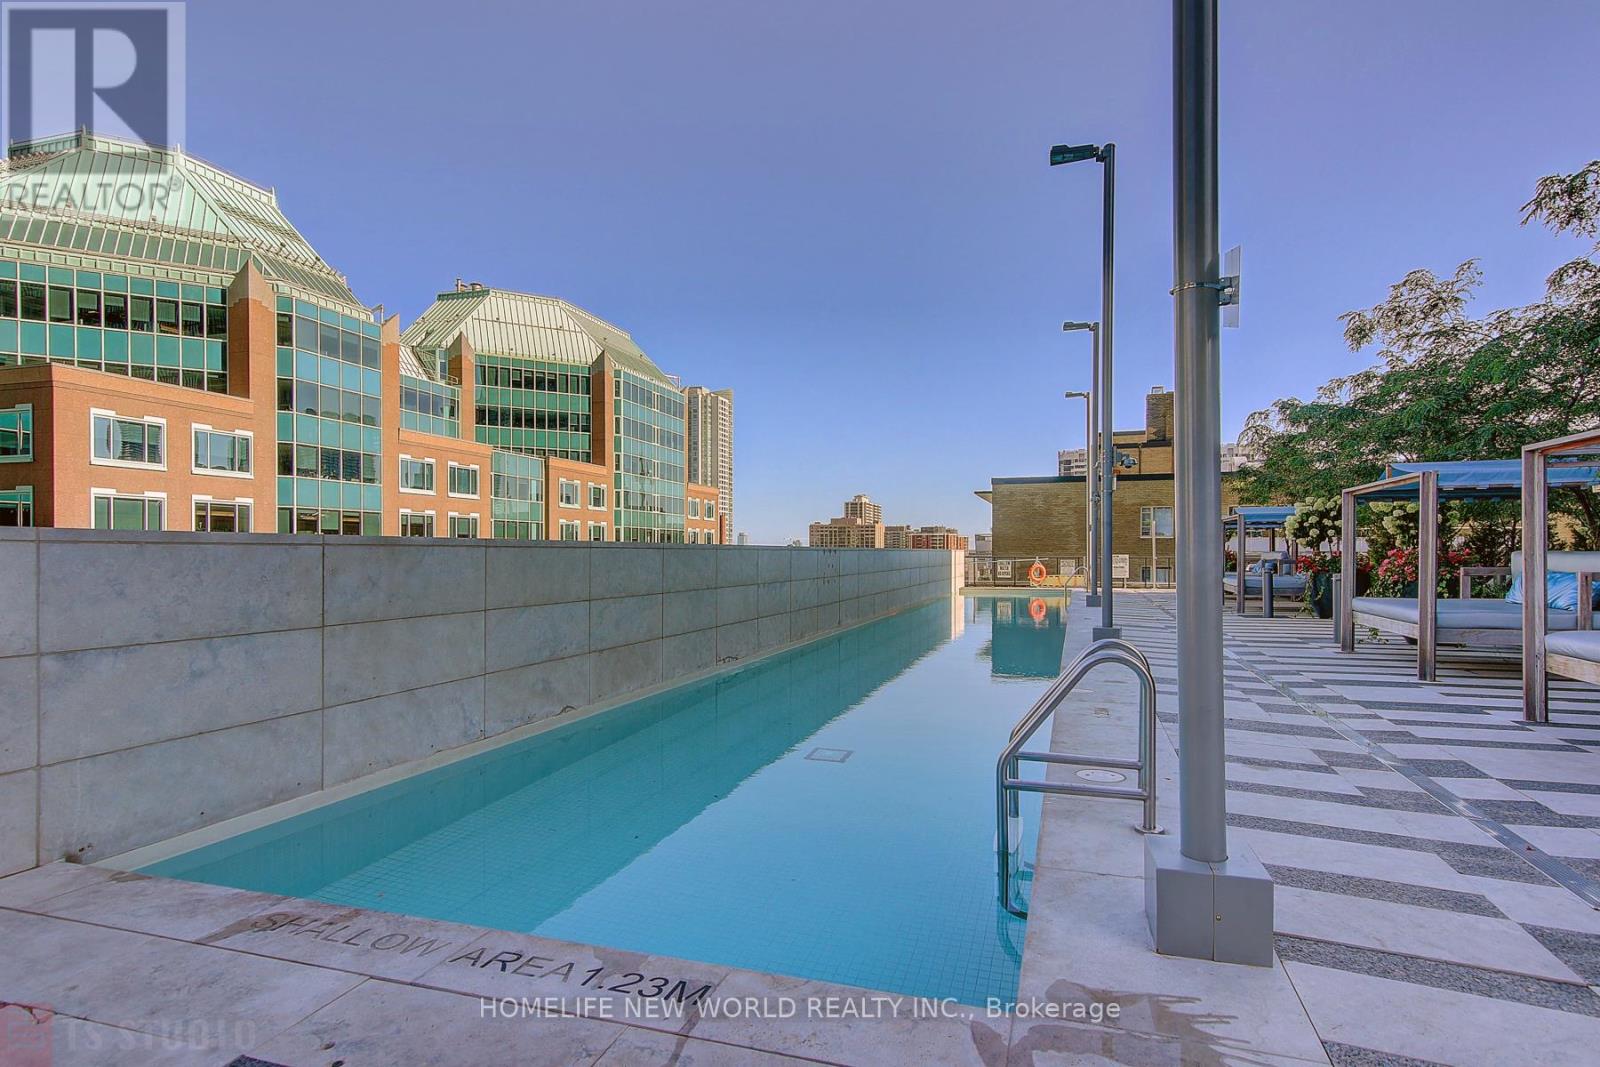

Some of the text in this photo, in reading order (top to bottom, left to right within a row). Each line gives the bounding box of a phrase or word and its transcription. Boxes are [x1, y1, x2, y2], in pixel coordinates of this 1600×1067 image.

[252, 913, 713, 1006] SHALLOW AREA 1.23M
